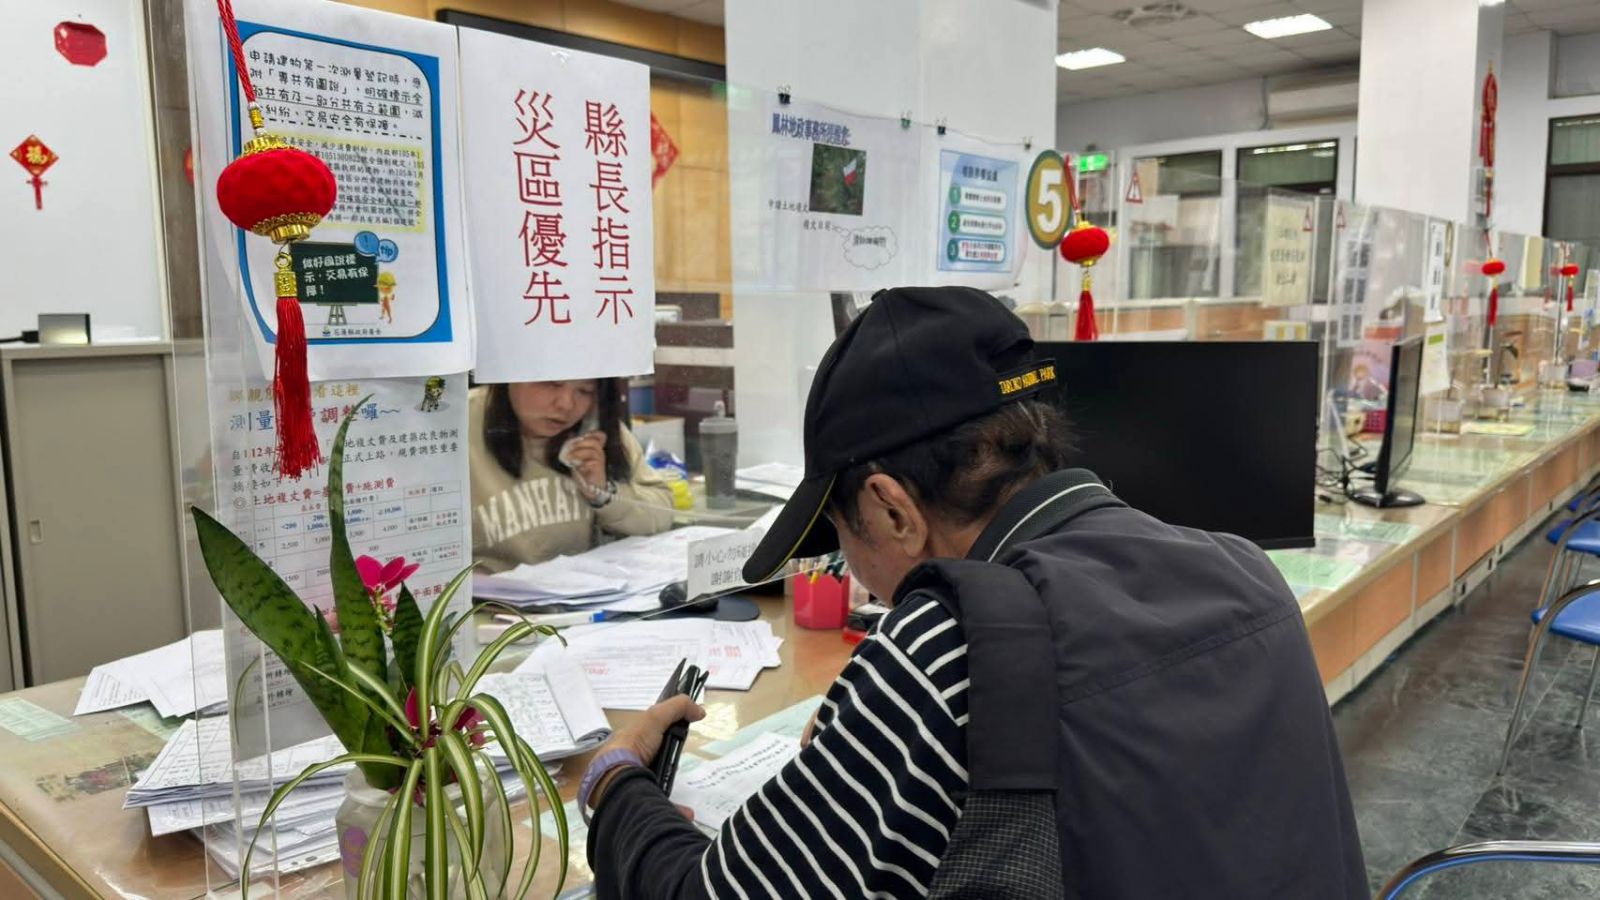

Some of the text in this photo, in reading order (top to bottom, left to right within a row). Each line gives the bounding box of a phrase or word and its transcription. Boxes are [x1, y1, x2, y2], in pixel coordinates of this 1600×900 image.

[513, 88, 572, 326] 災區優先
[584, 99, 634, 325] 縣長指示
[1037, 169, 1062, 233] 5
